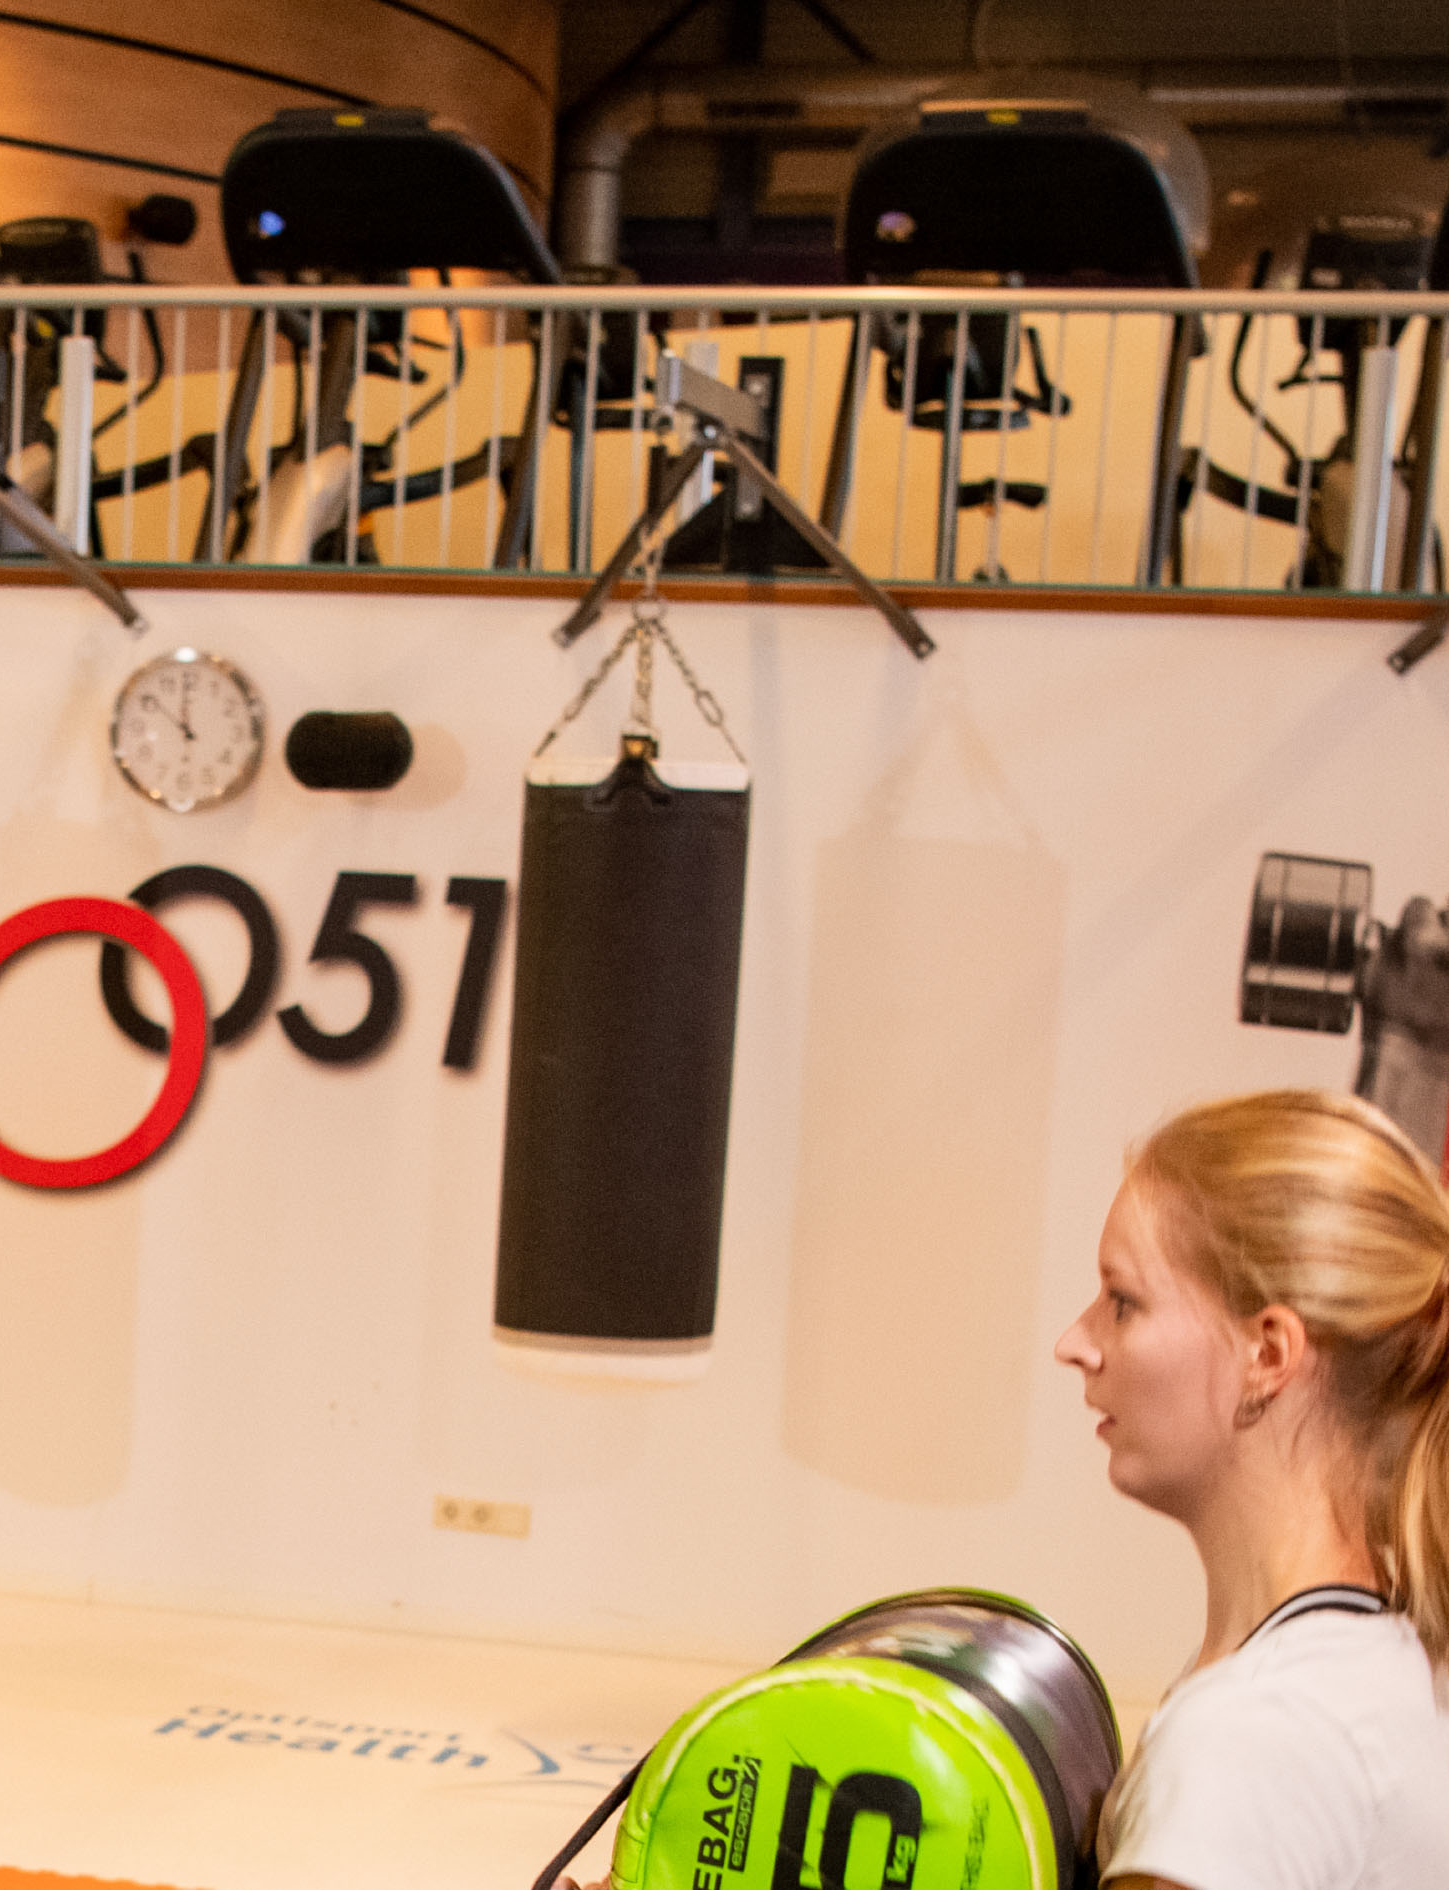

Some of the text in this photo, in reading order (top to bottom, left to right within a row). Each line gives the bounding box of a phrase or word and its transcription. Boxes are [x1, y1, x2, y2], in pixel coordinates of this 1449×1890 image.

[154, 1717, 490, 1769] Health
[731, 1784, 756, 1868] escape
[887, 1835, 918, 1884] kg
